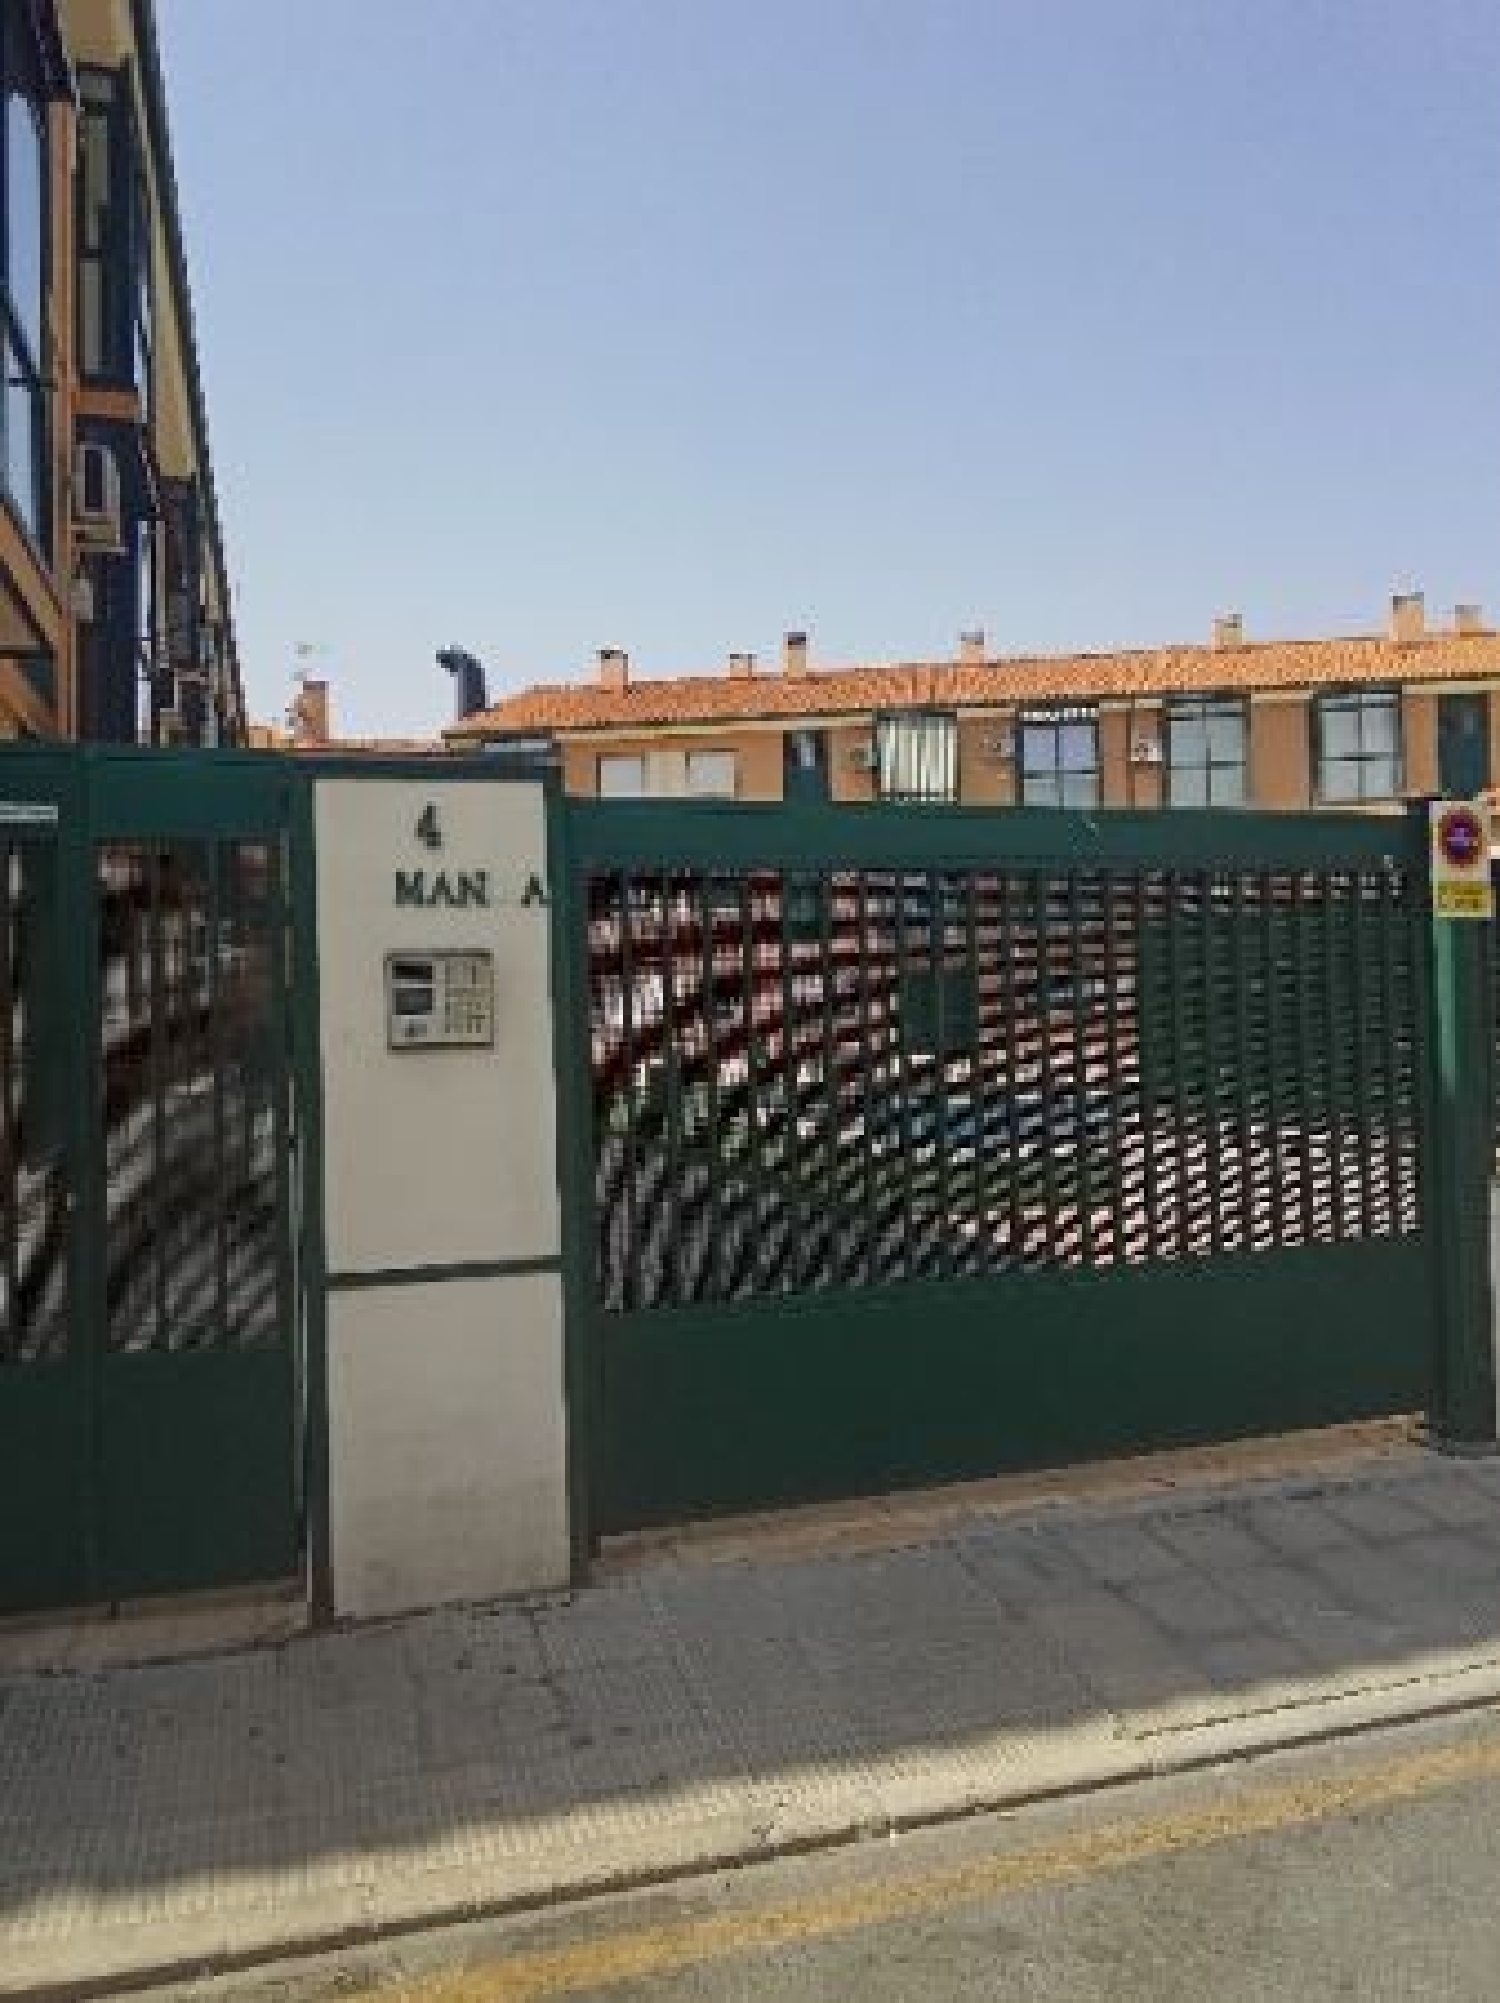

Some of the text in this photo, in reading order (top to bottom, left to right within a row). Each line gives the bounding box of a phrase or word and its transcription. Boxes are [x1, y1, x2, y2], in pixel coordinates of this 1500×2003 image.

[415, 802, 443, 848] 4
[395, 869, 551, 908] MAN A
